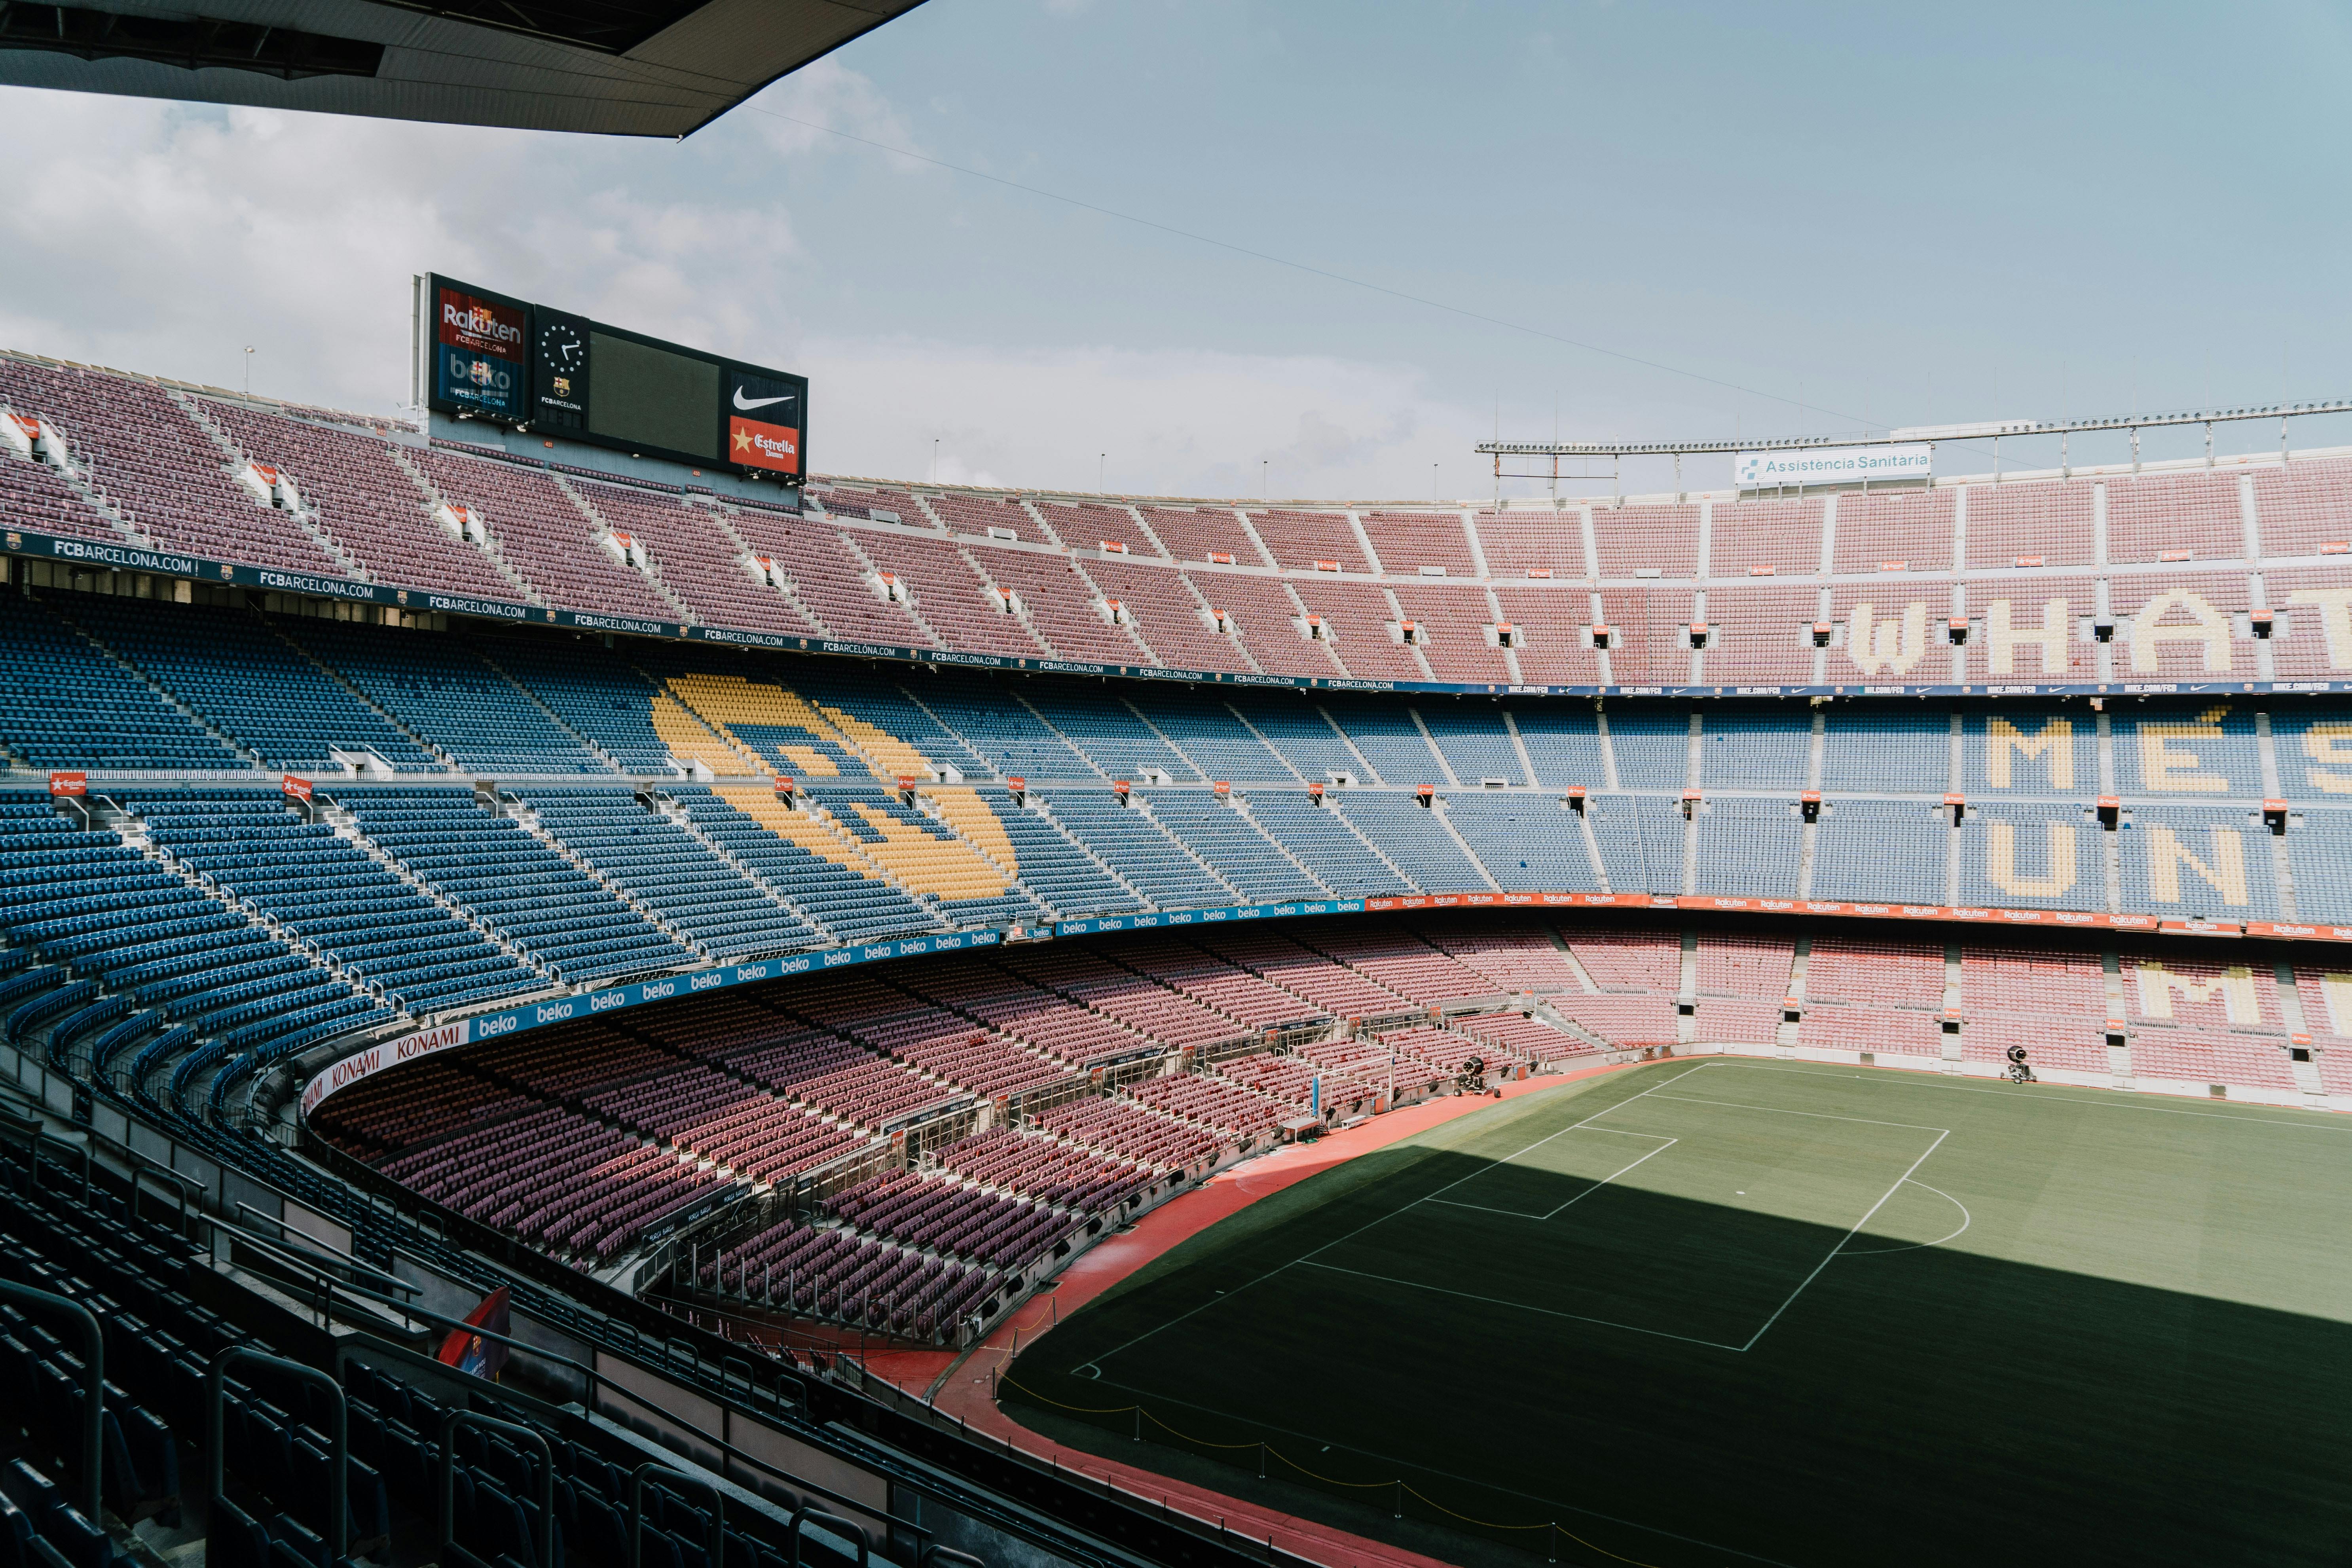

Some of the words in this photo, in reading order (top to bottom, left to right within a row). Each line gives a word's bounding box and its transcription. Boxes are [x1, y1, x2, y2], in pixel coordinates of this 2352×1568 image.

[444, 304, 520, 343] Rakuten
[542, 396, 581, 410] FCBARCELONA
[754, 434, 795, 454] Estrella
[766, 449, 783, 459] Damm
[1766, 458, 1854, 472] Assistència
[1858, 454, 1928, 468] Sanitària
[55, 540, 191, 573] FCBARCELONA.COM
[261, 572, 373, 598] FCBARCELONA.COM
[430, 596, 525, 618] FCBARCELONA.COM
[576, 615, 660, 633] FCBARCELONA.COM
[706, 630, 782, 646] FCBARCELONA.COM
[824, 643, 894, 656] FCBARCELONA.COM
[932, 653, 1000, 665] FCBARCELONA.COM
[1040, 662, 1103, 673] FCBARCELONA.COM
[1140, 669, 1202, 679] FCBARCELONA.COM
[1234, 675, 1294, 685] FCBARCELONA.COM
[1328, 680, 1393, 690] FCBARCELONA.COM
[2124, 684, 2177, 692] NIKE.COM/FCB
[2272, 682, 2330, 691] NIKE.COM/FCB
[293, 783, 311, 793] Estrella
[1586, 895, 1614, 904] Rakuten
[1761, 901, 1792, 909] Rakuten
[1275, 906, 1295, 915] beko
[1305, 904, 1326, 912] beko
[1338, 902, 1359, 910] beko
[1808, 903, 1840, 912] Rakuten
[1855, 906, 1888, 914] Rakuten
[1170, 913, 1191, 923] beko
[1204, 910, 1225, 920] beko
[1239, 908, 1259, 918] beko
[2005, 912, 2040, 920] Rakuten
[2057, 914, 2093, 923] Rakuten
[1100, 920, 1121, 929] beko
[1135, 916, 1157, 926] beko
[2110, 916, 2147, 925] Rakuten
[1064, 923, 1086, 933] beko
[2274, 925, 2314, 935] Rakuten
[937, 937, 960, 948] beko
[972, 932, 995, 944] beko
[865, 946, 890, 959] beko
[901, 941, 926, 954] beko
[825, 952, 850, 965] beko
[782, 958, 809, 973] beko
[738, 965, 766, 980] beko
[692, 973, 721, 990] beko
[643, 982, 674, 999] beko
[592, 992, 624, 1011] beko
[538, 1003, 572, 1022] beko
[480, 1016, 516, 1036] beko
[397, 1026, 459, 1060] KONAMI
[332, 1050, 379, 1089] KONAMI
[724, 1193, 734, 1202] FORÇA
[689, 1212, 699, 1222] FORÇA
[700, 1203, 711, 1215] BARÇA!
